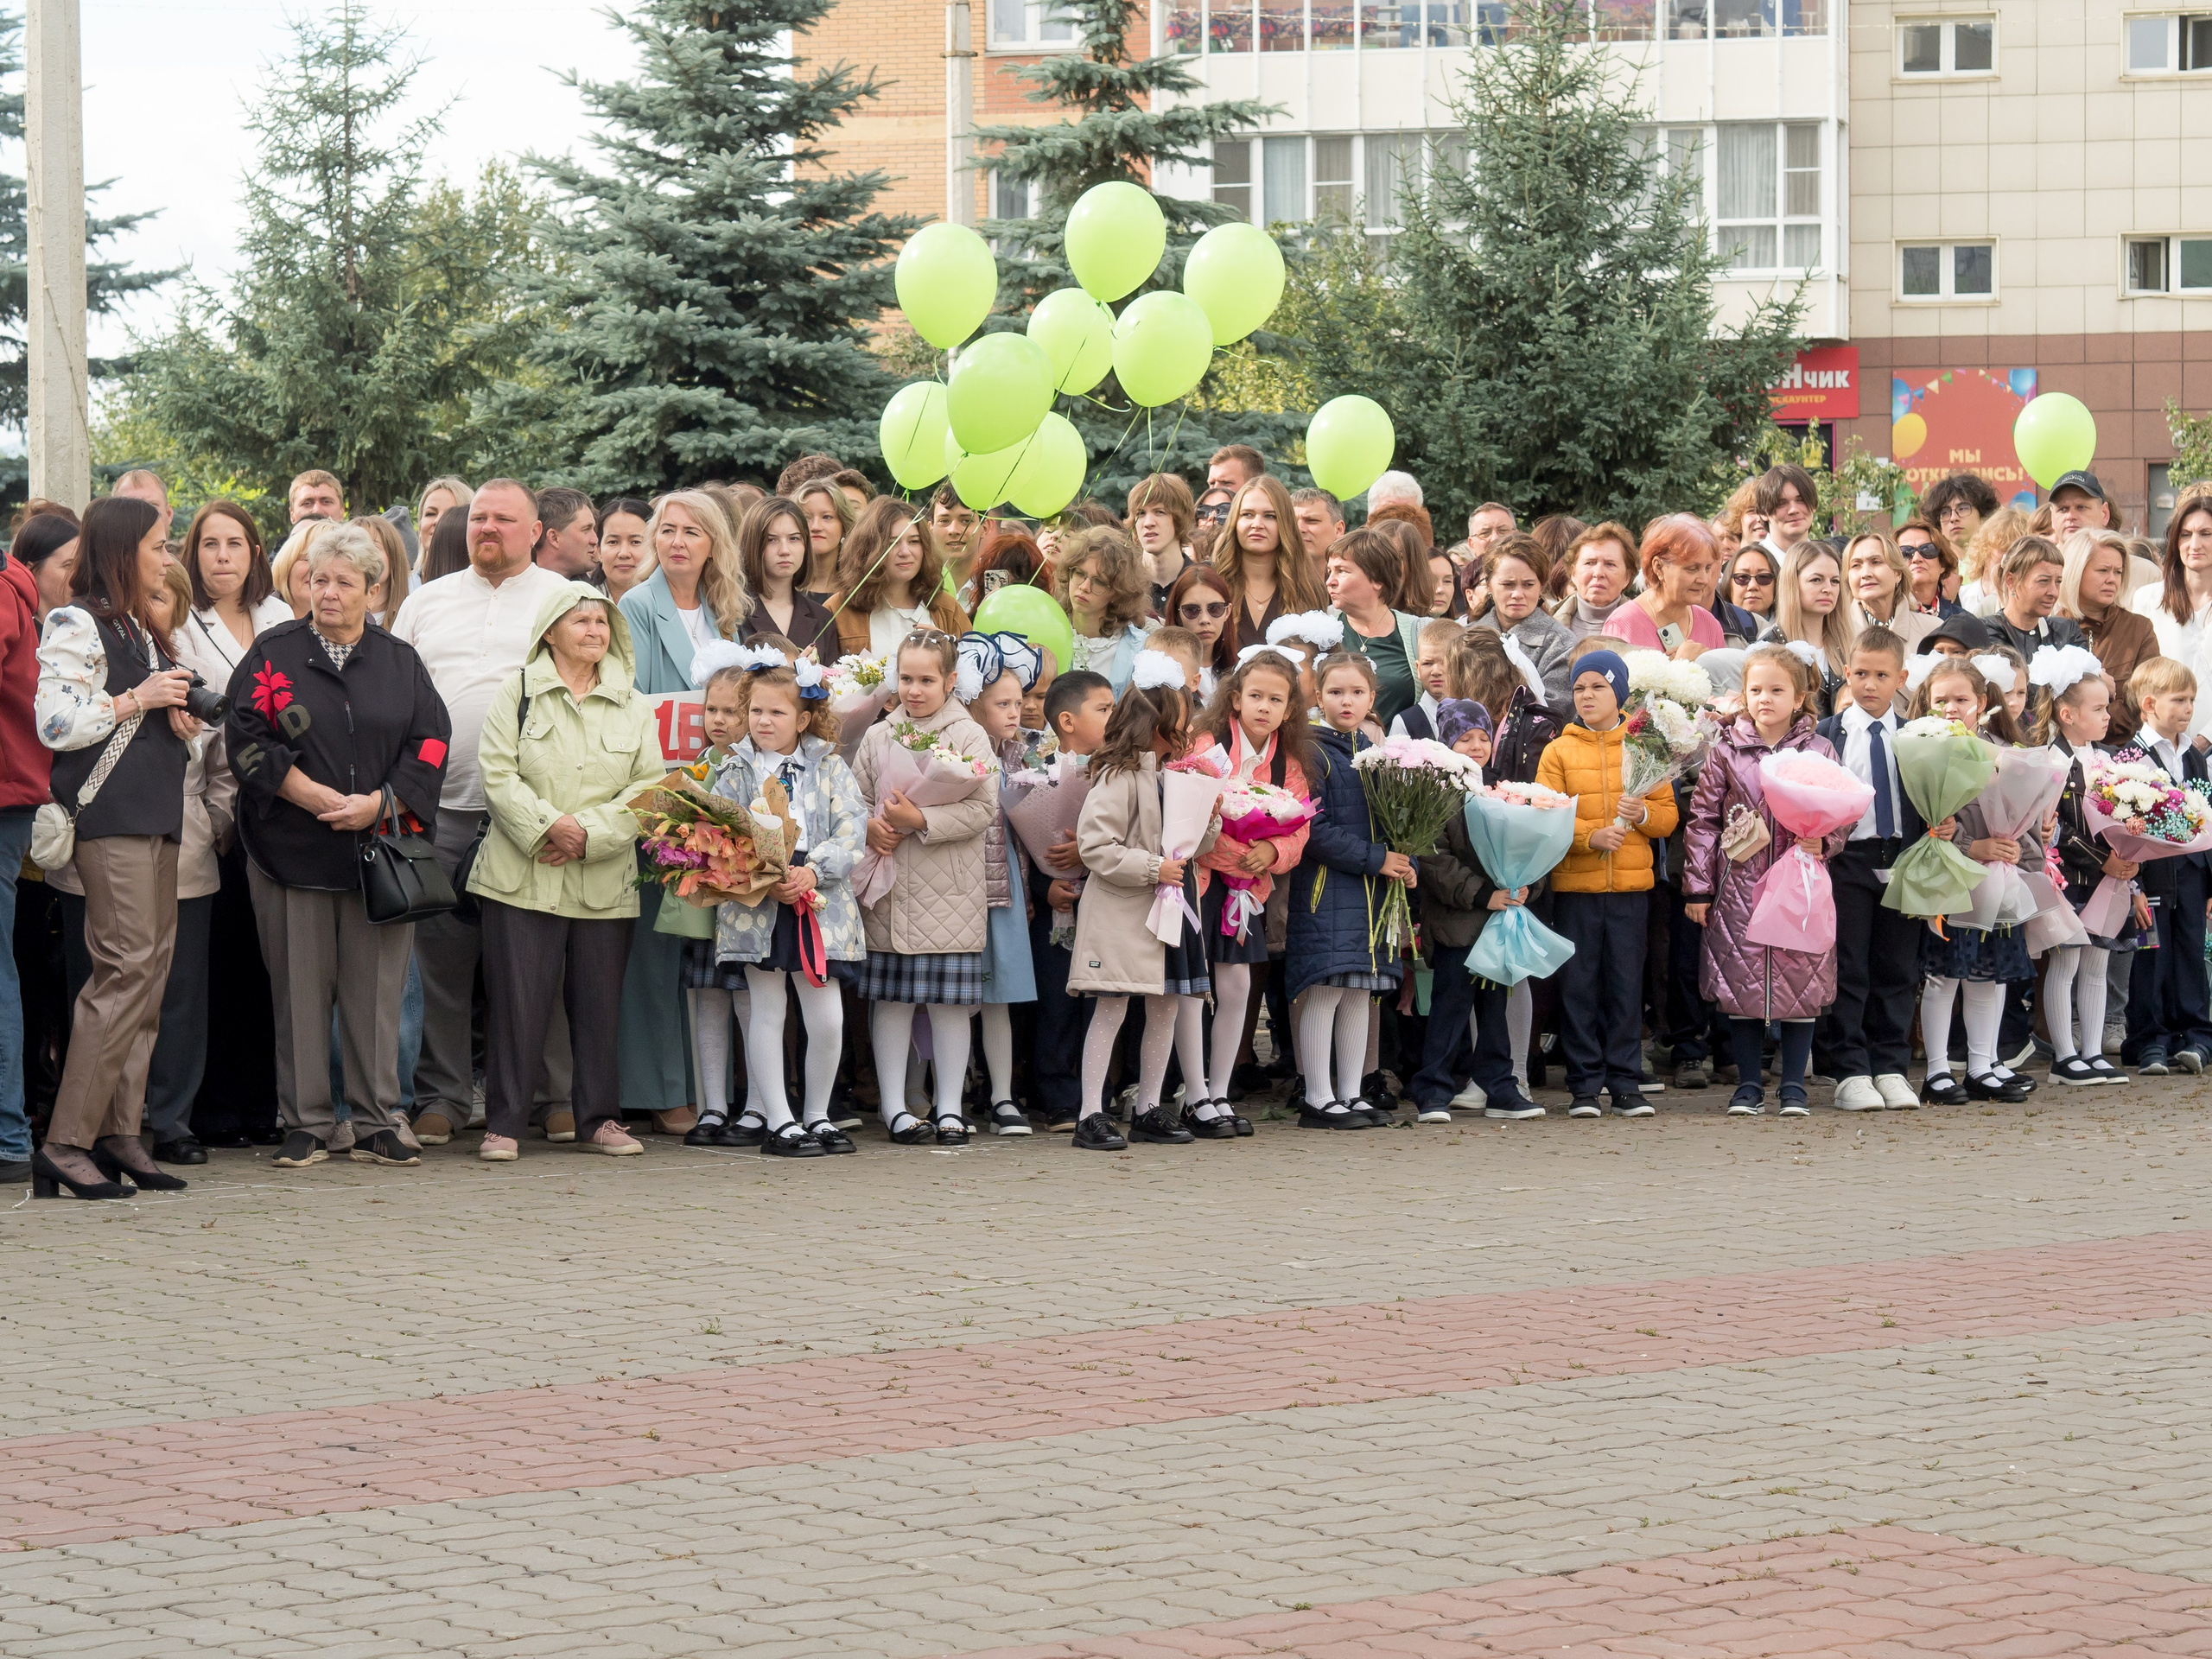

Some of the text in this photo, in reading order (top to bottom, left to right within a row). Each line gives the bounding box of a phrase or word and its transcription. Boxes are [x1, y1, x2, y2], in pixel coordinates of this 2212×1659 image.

[1949, 448, 1981, 464] МЫ
[1904, 467, 2024, 482] ОТКРЛИСЬ!
[113, 619, 126, 639] GITAL
[277, 704, 311, 741] D
